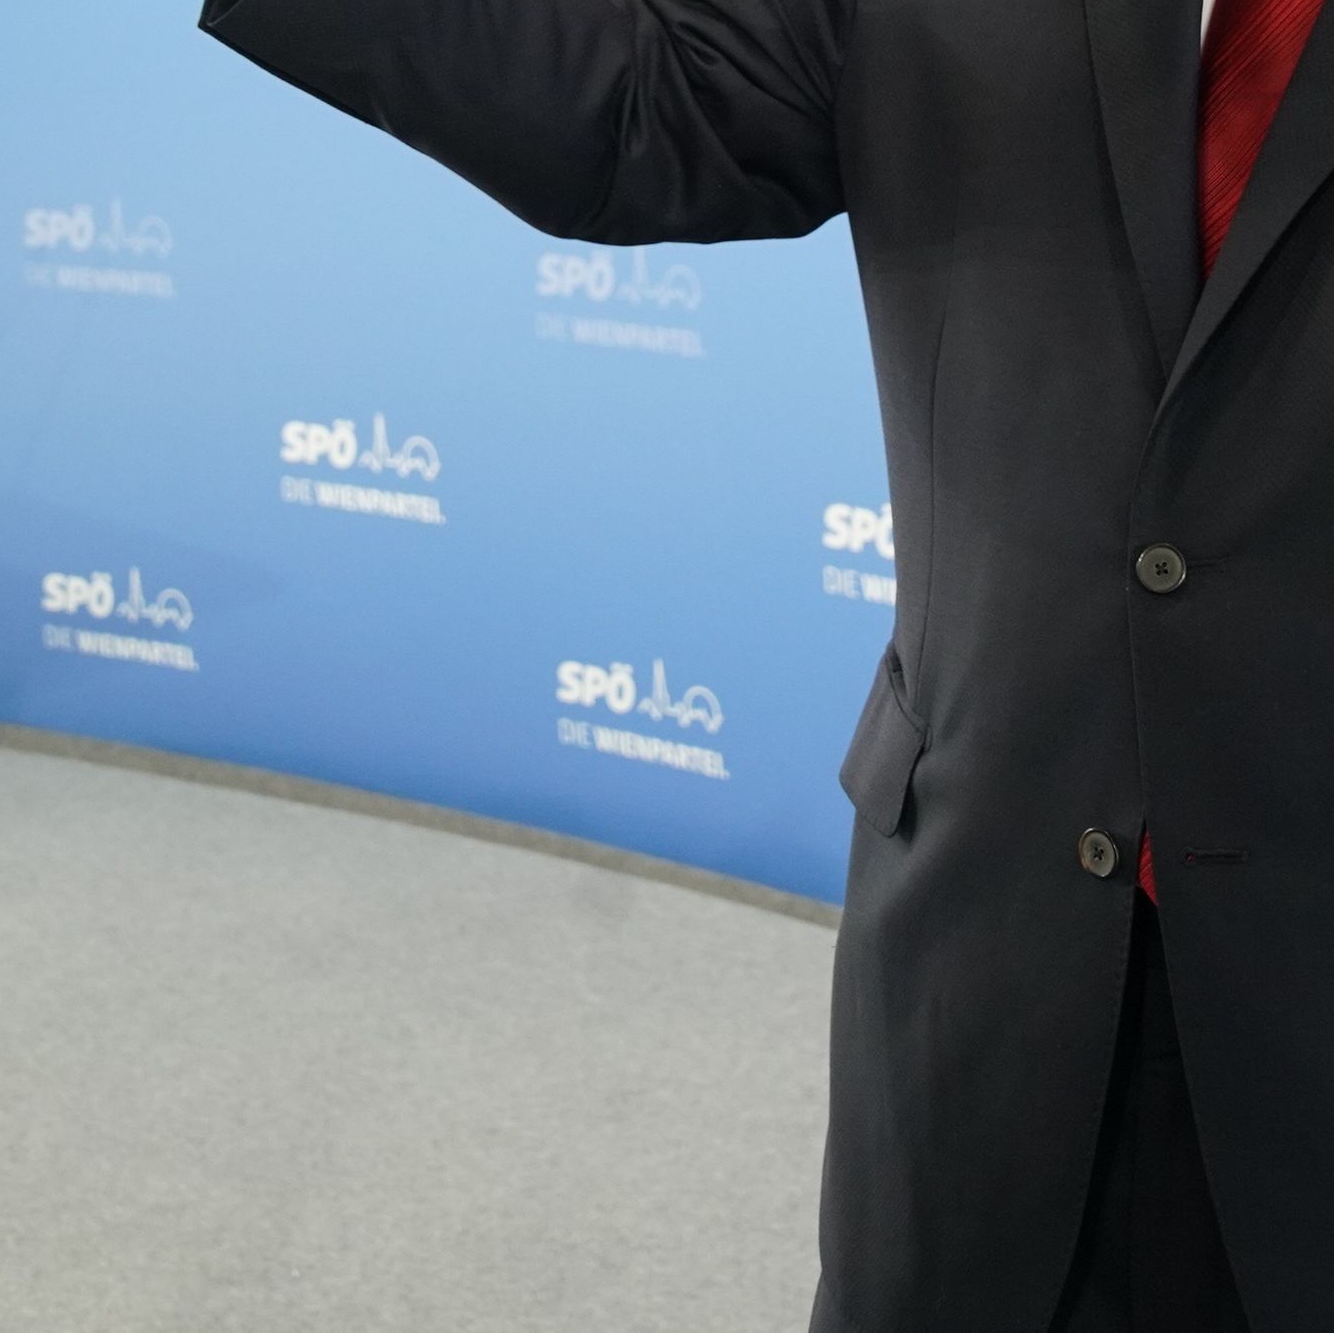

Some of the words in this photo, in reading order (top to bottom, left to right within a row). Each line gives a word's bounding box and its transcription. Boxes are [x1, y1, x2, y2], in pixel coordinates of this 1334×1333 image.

[279, 418, 358, 470] SPÖ
[41, 571, 115, 619] SPÖ
[556, 660, 636, 714] SPÖ
